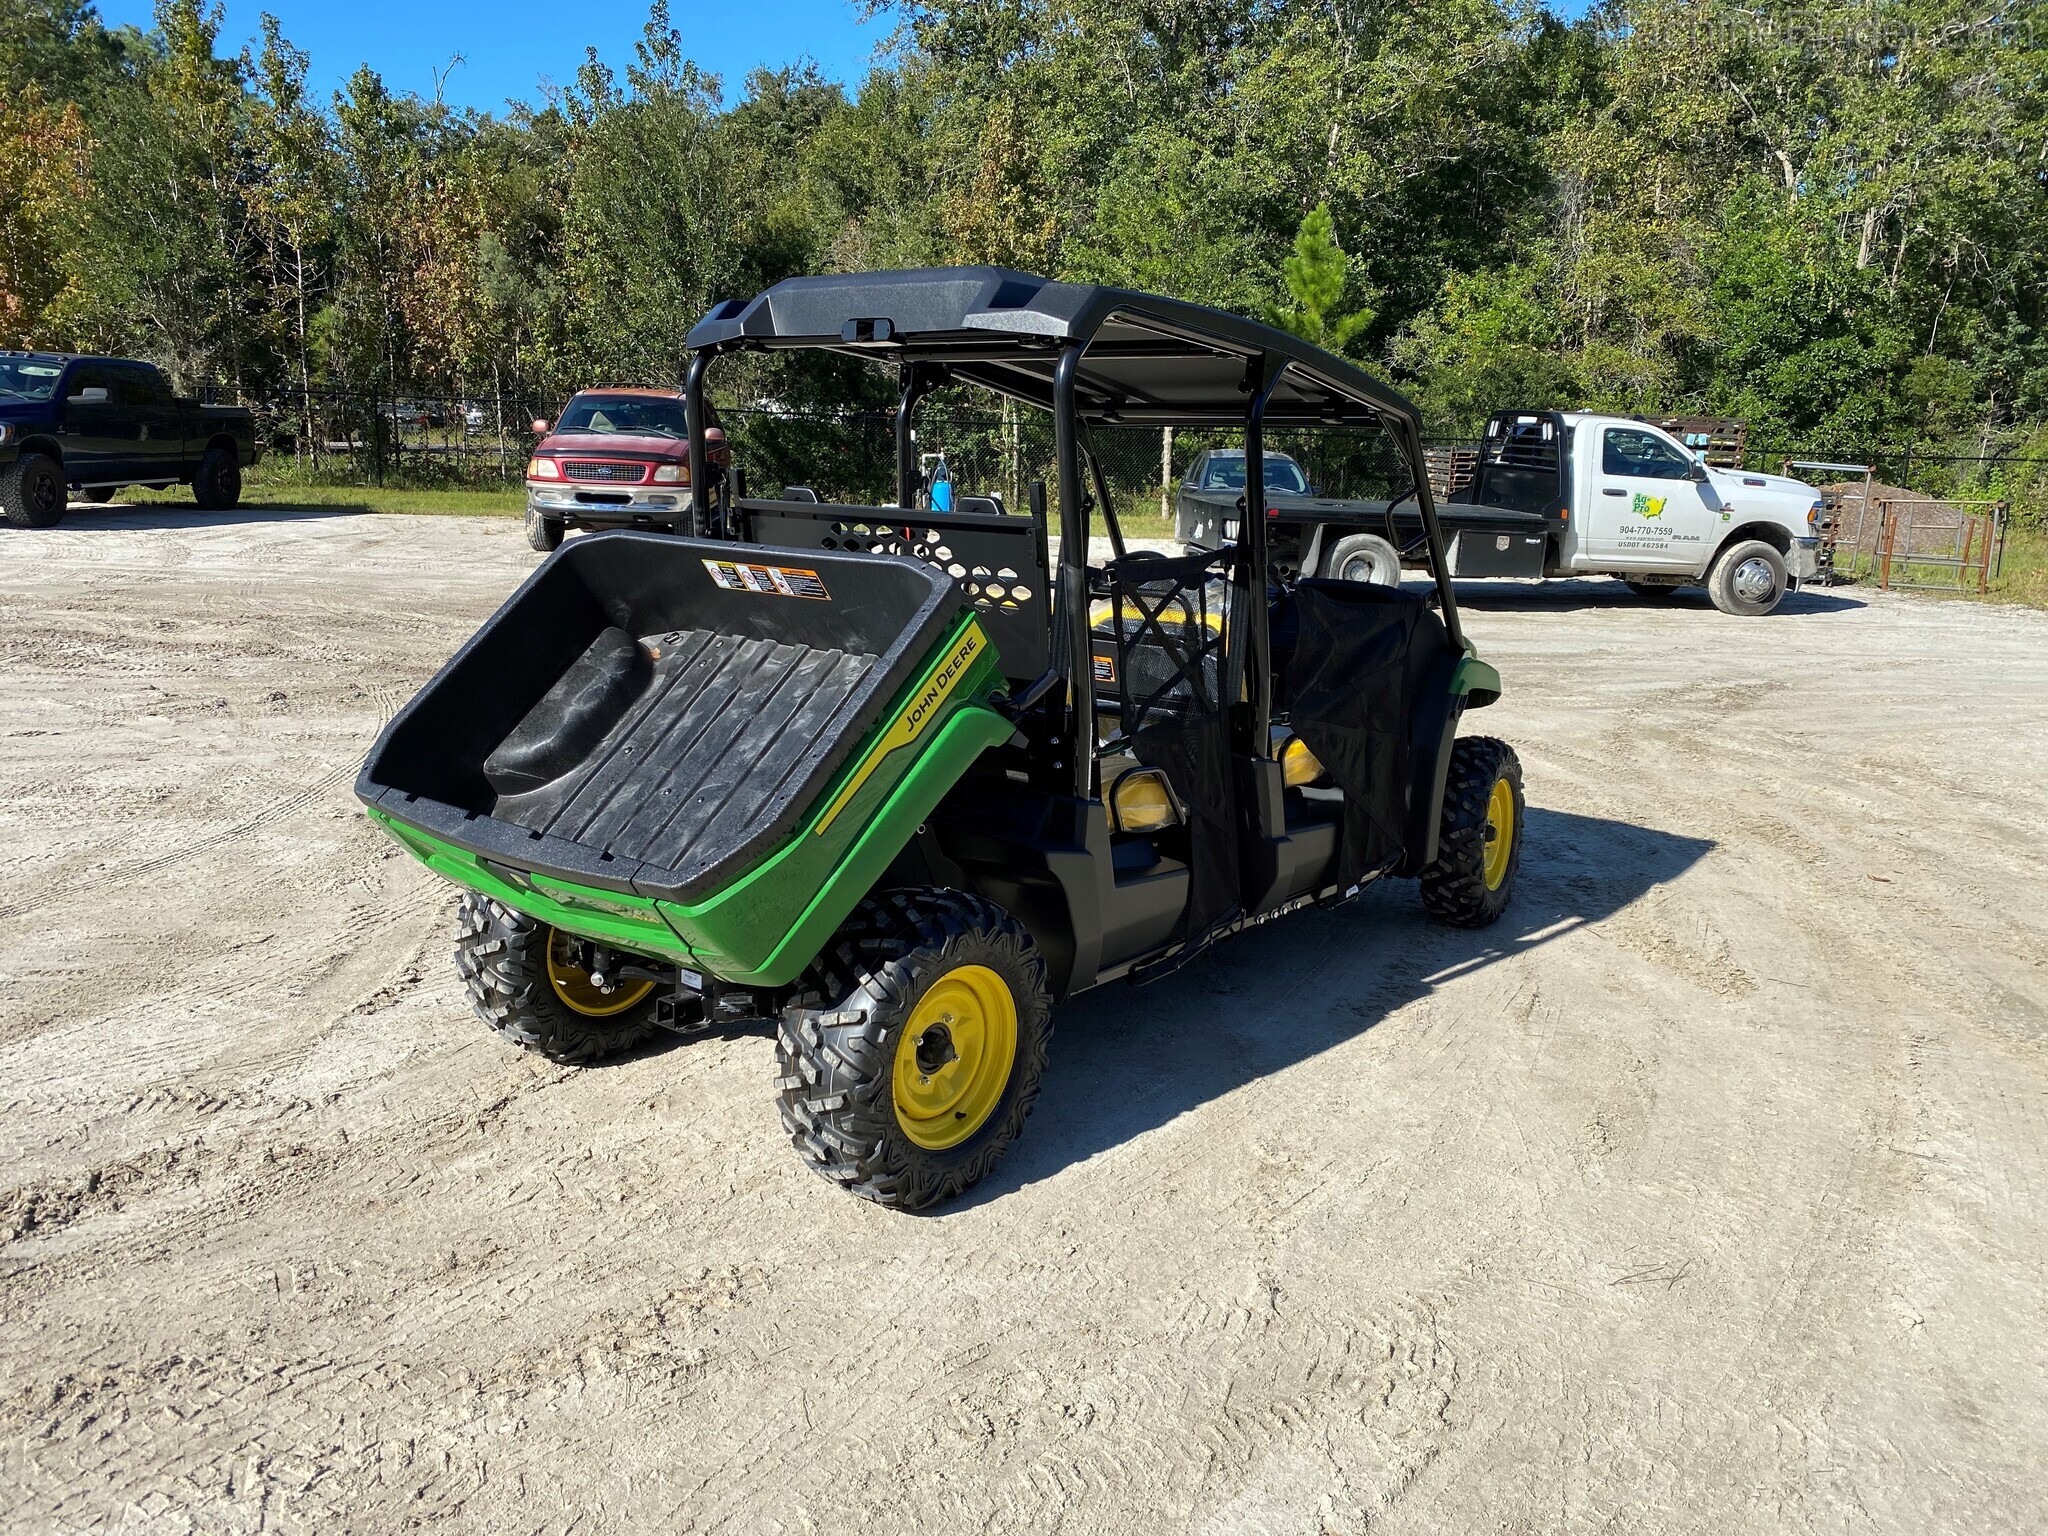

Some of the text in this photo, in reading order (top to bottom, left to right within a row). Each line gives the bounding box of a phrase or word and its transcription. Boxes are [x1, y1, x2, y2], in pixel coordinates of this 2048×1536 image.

[1634, 494, 1650, 505] Ag-
[1633, 503, 1649, 513] Pro
[1619, 526, 1673, 536] 904-770-7559
[906, 637, 977, 732] JOHN DEERE
